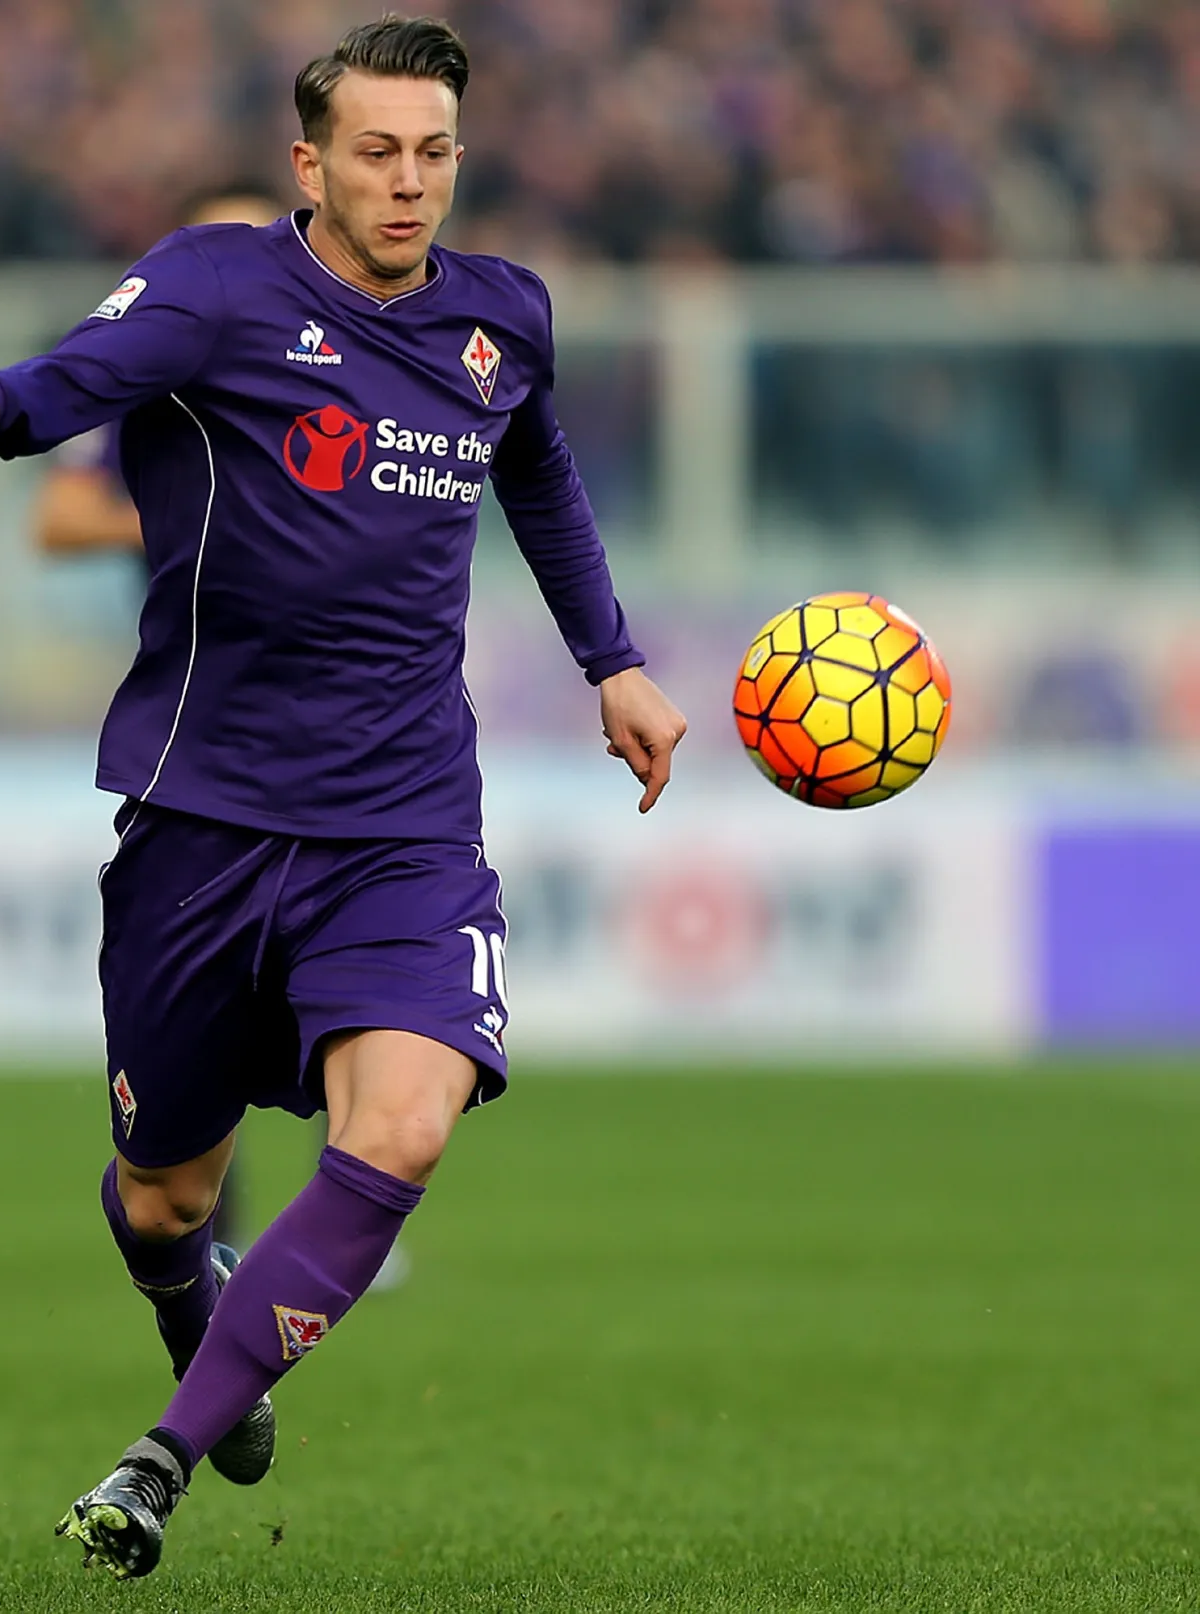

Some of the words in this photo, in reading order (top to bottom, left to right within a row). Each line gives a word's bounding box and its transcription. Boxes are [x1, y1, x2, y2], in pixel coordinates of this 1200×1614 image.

[286, 349, 295, 360] le
[295, 352, 312, 365] coq
[376, 418, 449, 457] Save
[457, 432, 492, 464] the
[371, 461, 482, 503] Children
